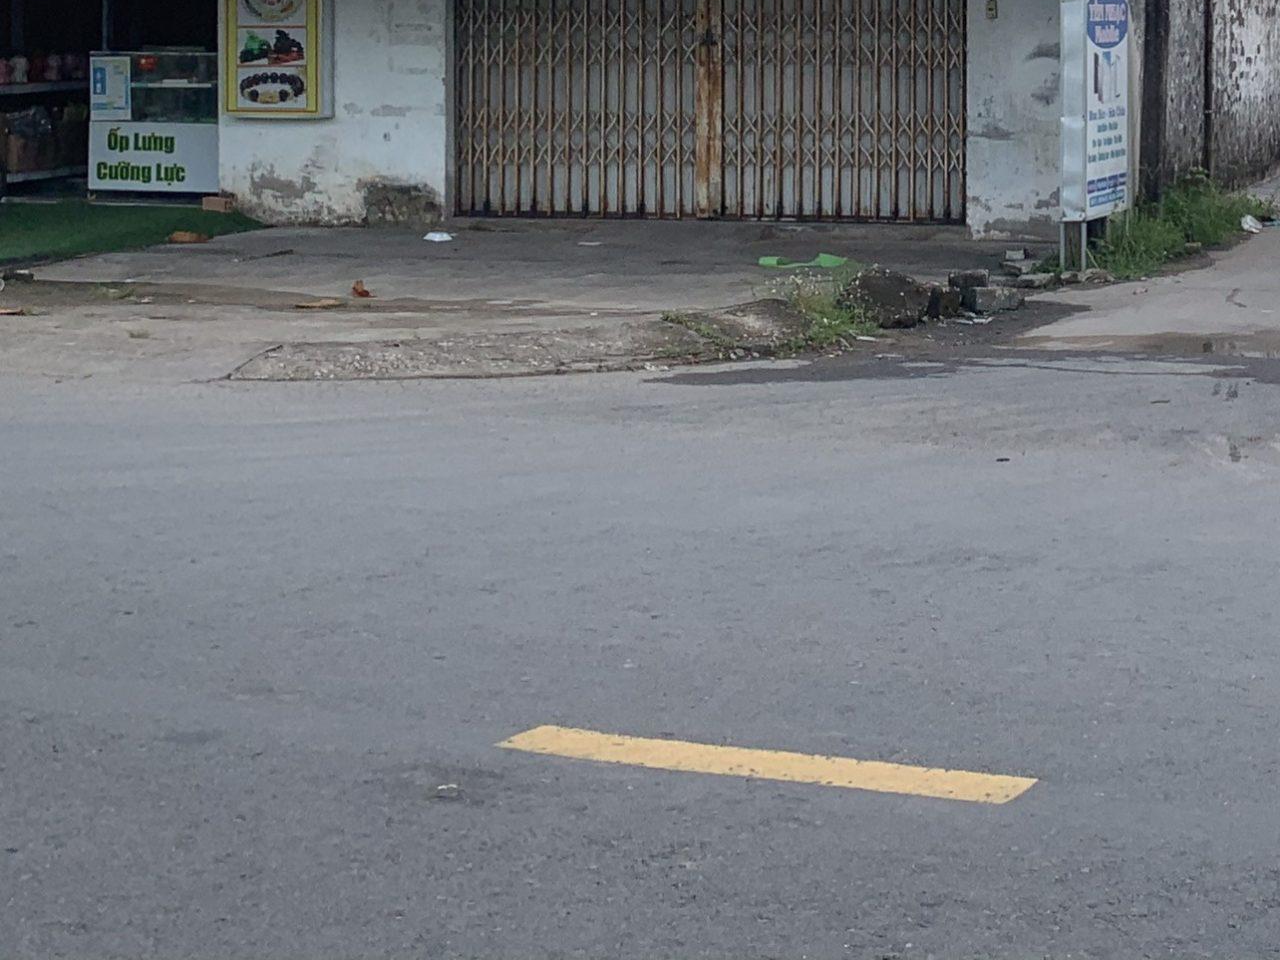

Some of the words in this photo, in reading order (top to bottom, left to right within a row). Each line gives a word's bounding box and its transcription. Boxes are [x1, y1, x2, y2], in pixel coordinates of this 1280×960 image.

[107, 127, 129, 152] Ốp
[133, 132, 175, 154] Lưng
[96, 161, 151, 183] Cường
[156, 163, 186, 186] Lực
